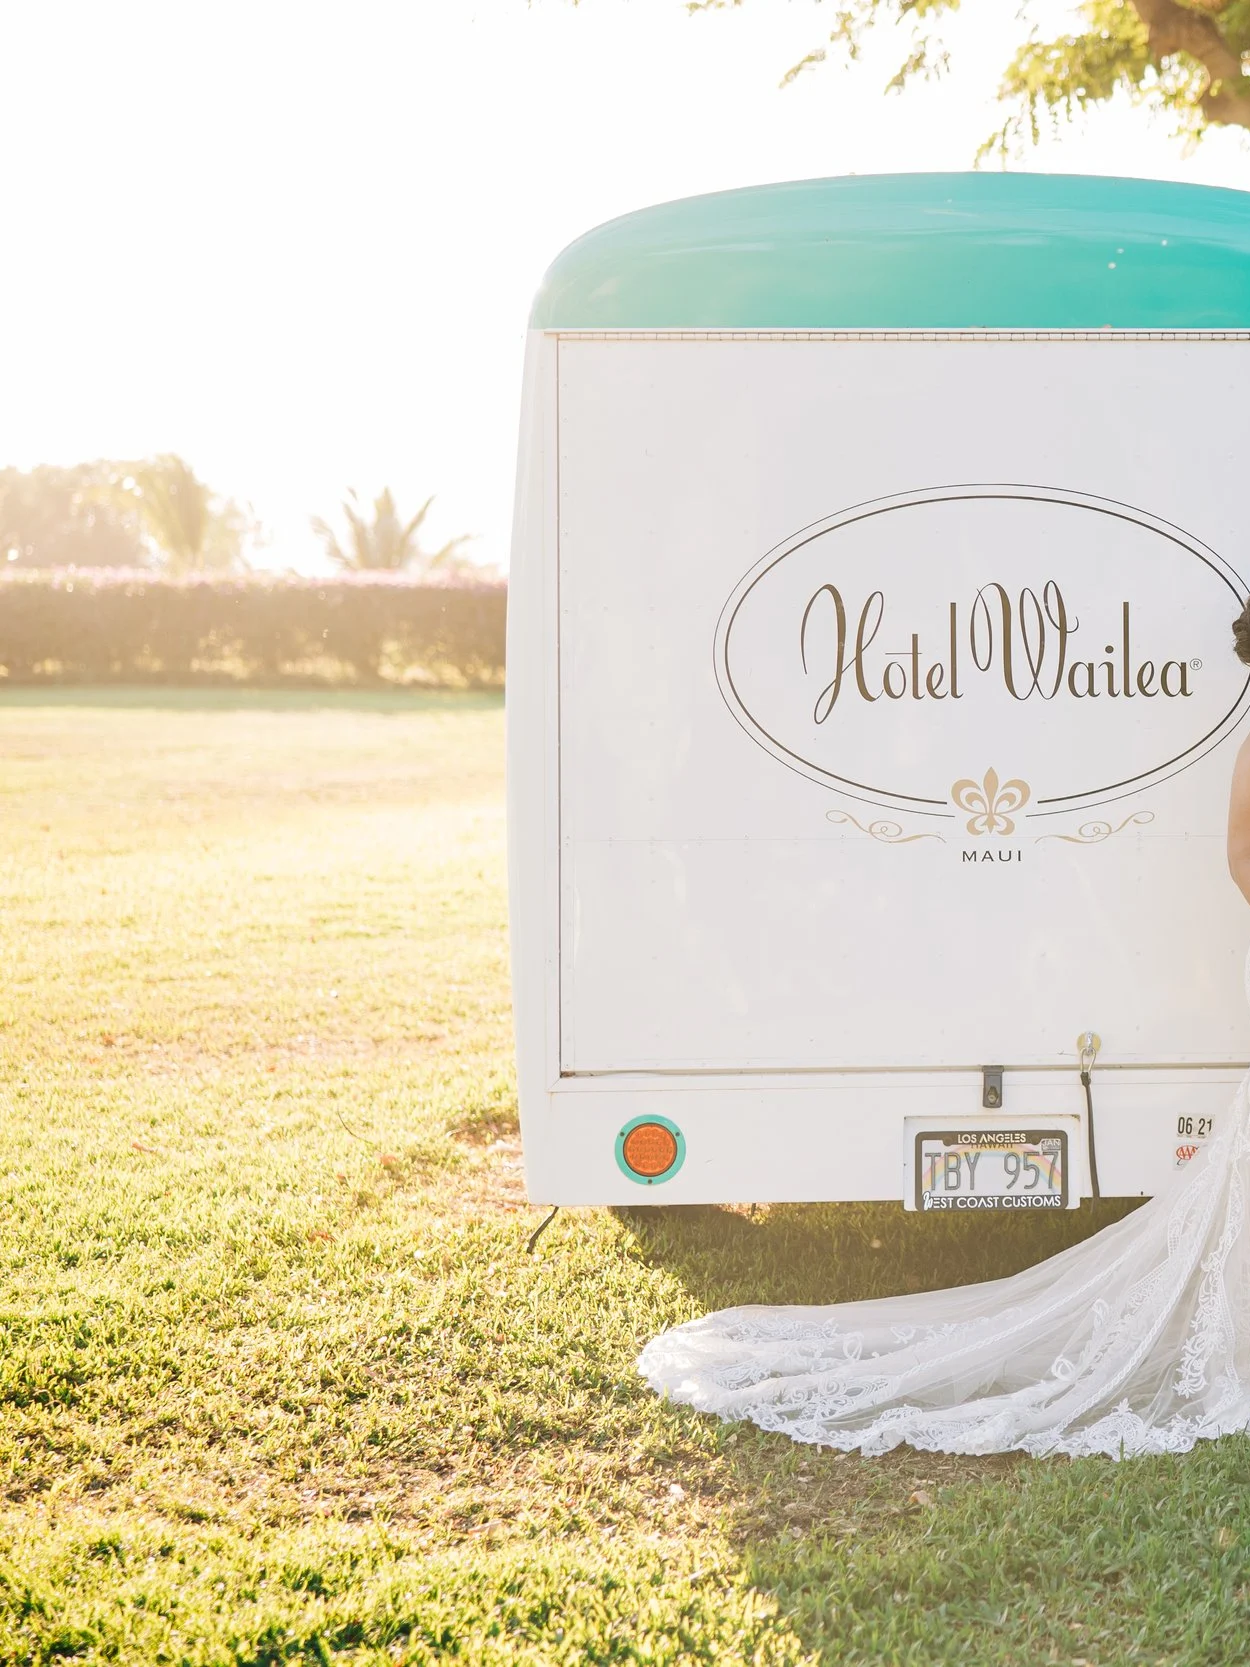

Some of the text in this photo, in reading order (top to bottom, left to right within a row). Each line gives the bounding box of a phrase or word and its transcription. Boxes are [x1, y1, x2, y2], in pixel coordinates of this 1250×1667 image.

[961, 849, 1022, 862] MAUI
[1178, 1116, 1212, 1135] 06 21
[957, 1133, 1027, 1144] LOS ANGELES
[924, 1151, 1060, 1191] TBY 957
[923, 1191, 1061, 1211] WEST COAST CUSTOMS
